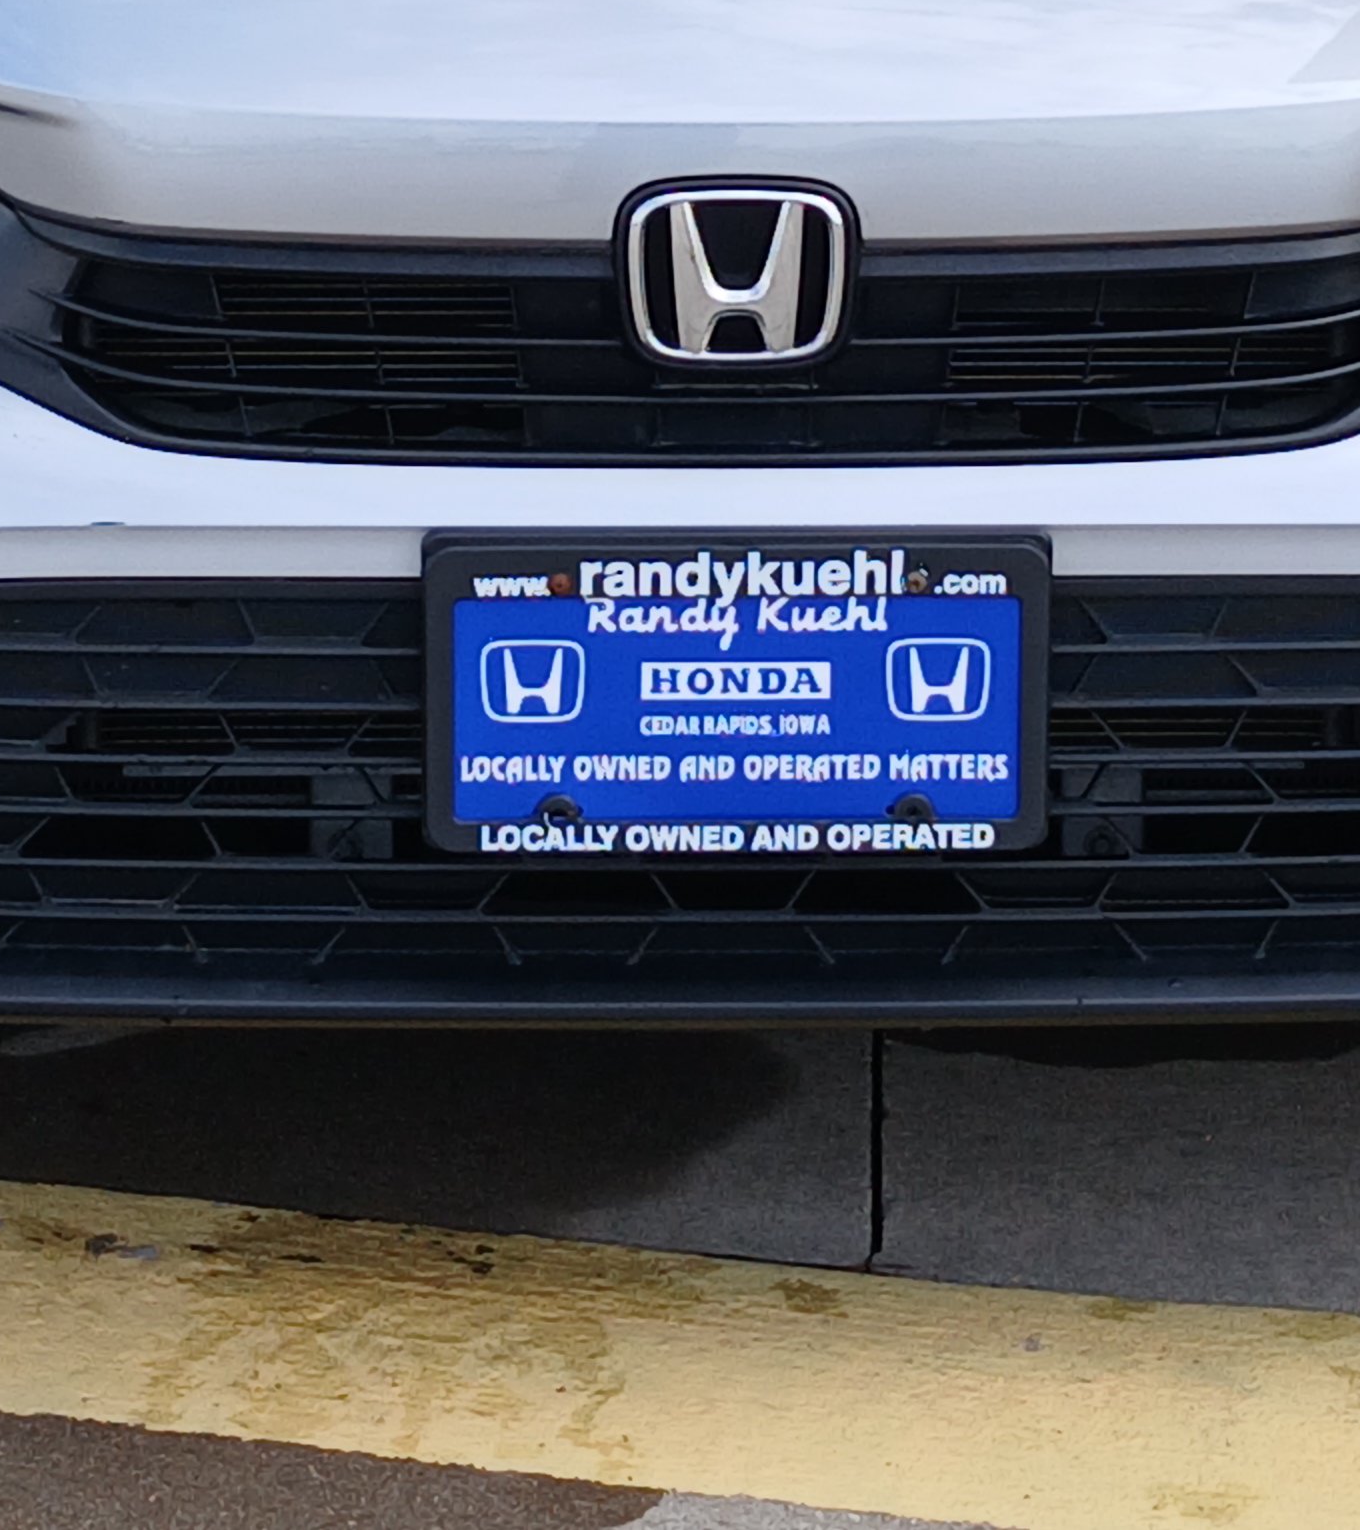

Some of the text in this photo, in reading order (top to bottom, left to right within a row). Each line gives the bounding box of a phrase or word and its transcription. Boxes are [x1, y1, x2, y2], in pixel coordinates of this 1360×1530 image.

[579, 549, 905, 608] randykuehl
[583, 596, 888, 651] Randy Kuehl
[650, 667, 823, 695] HONDA
[639, 715, 701, 736] CEDAR
[779, 714, 831, 735] IOWA
[460, 753, 1008, 783] LOCALLY OWNED AND OPERATED MATTERS
[480, 823, 995, 852] LOCALLY OWNED AND OPERATED
